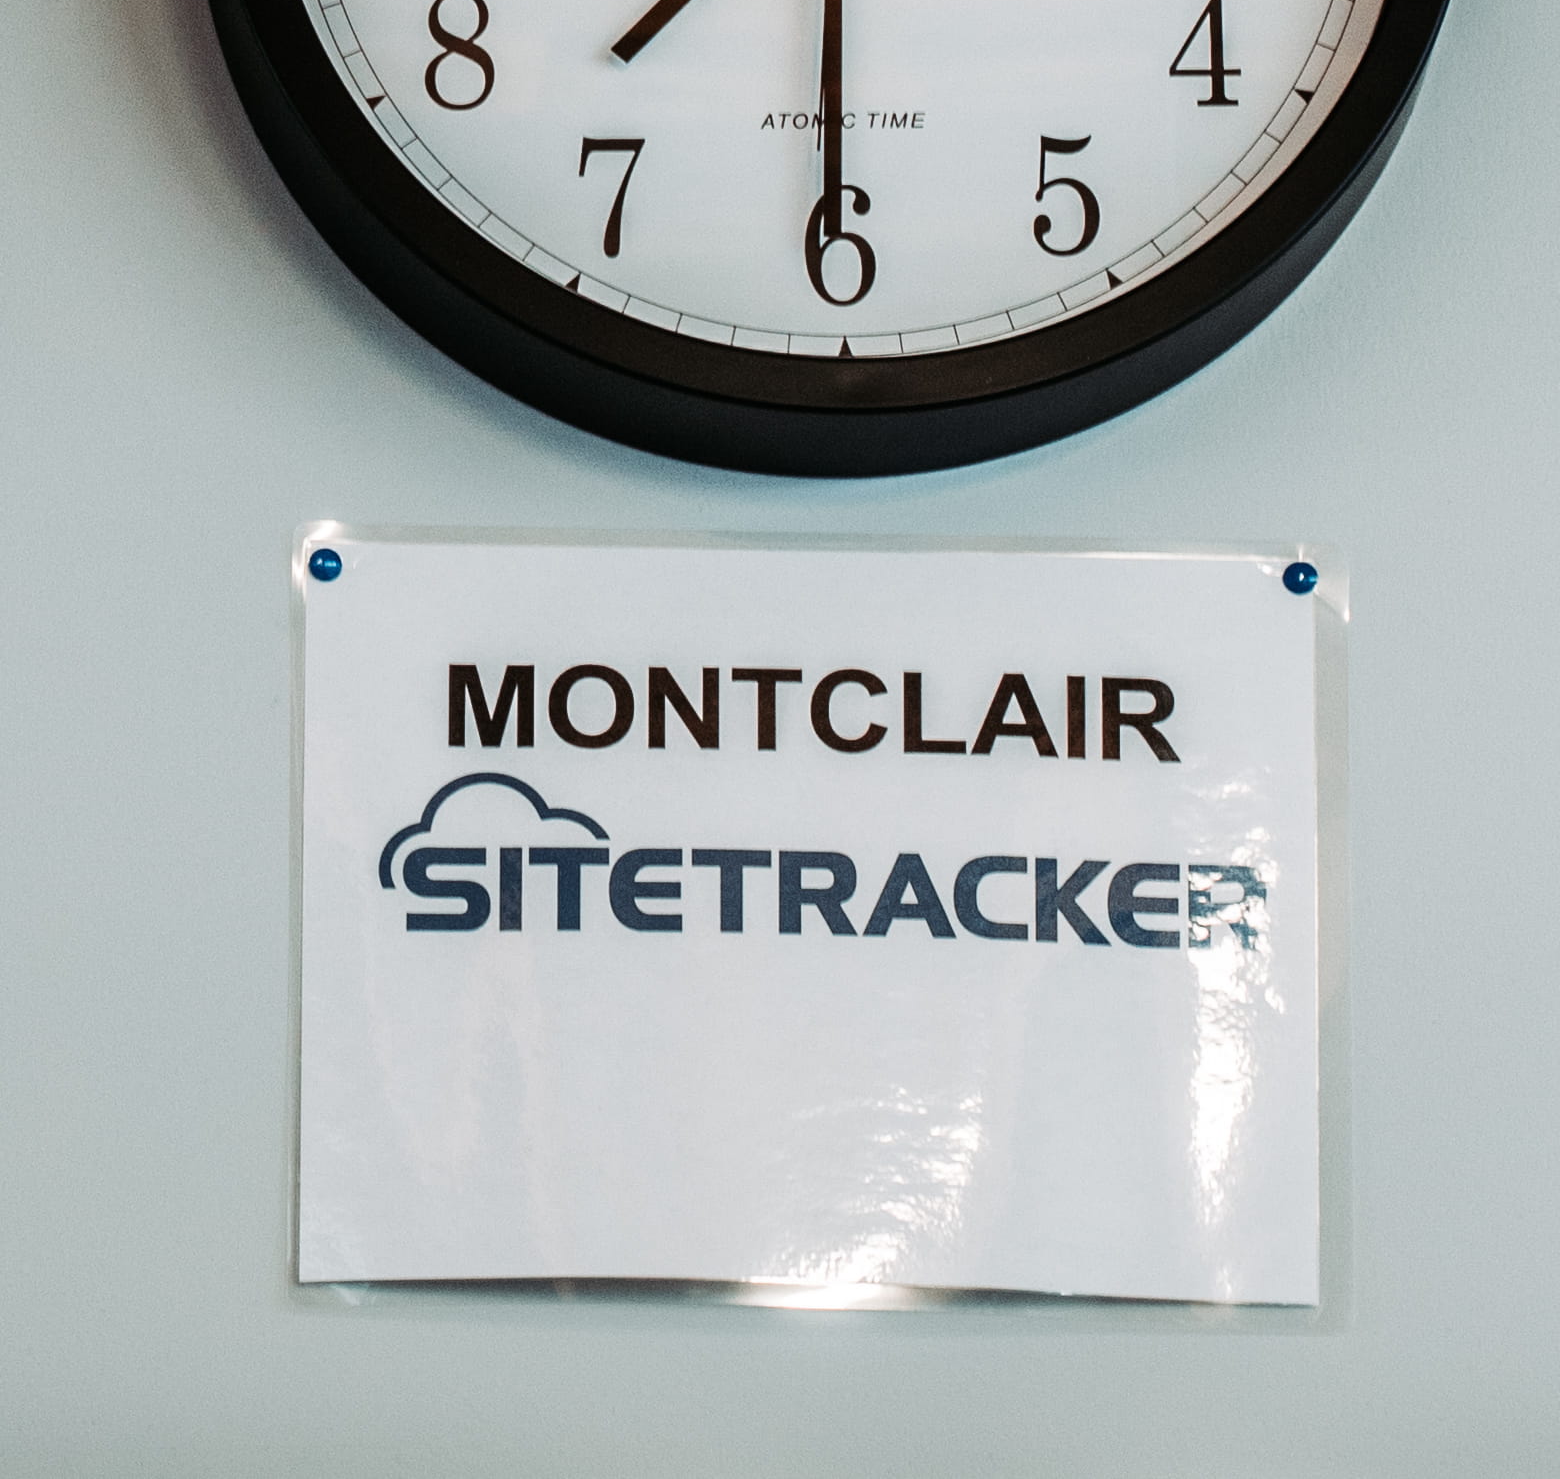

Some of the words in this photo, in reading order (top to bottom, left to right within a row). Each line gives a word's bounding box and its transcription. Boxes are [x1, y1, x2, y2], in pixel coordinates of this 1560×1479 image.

[761, 113, 856, 129] ATOMC
[868, 112, 926, 129] TIME
[579, 137, 645, 258] 7
[805, 183, 876, 306] 6
[1034, 135, 1100, 256] 5
[448, 664, 1180, 762] MONTCLAIR
[403, 845, 1268, 951] SITETRACKER
